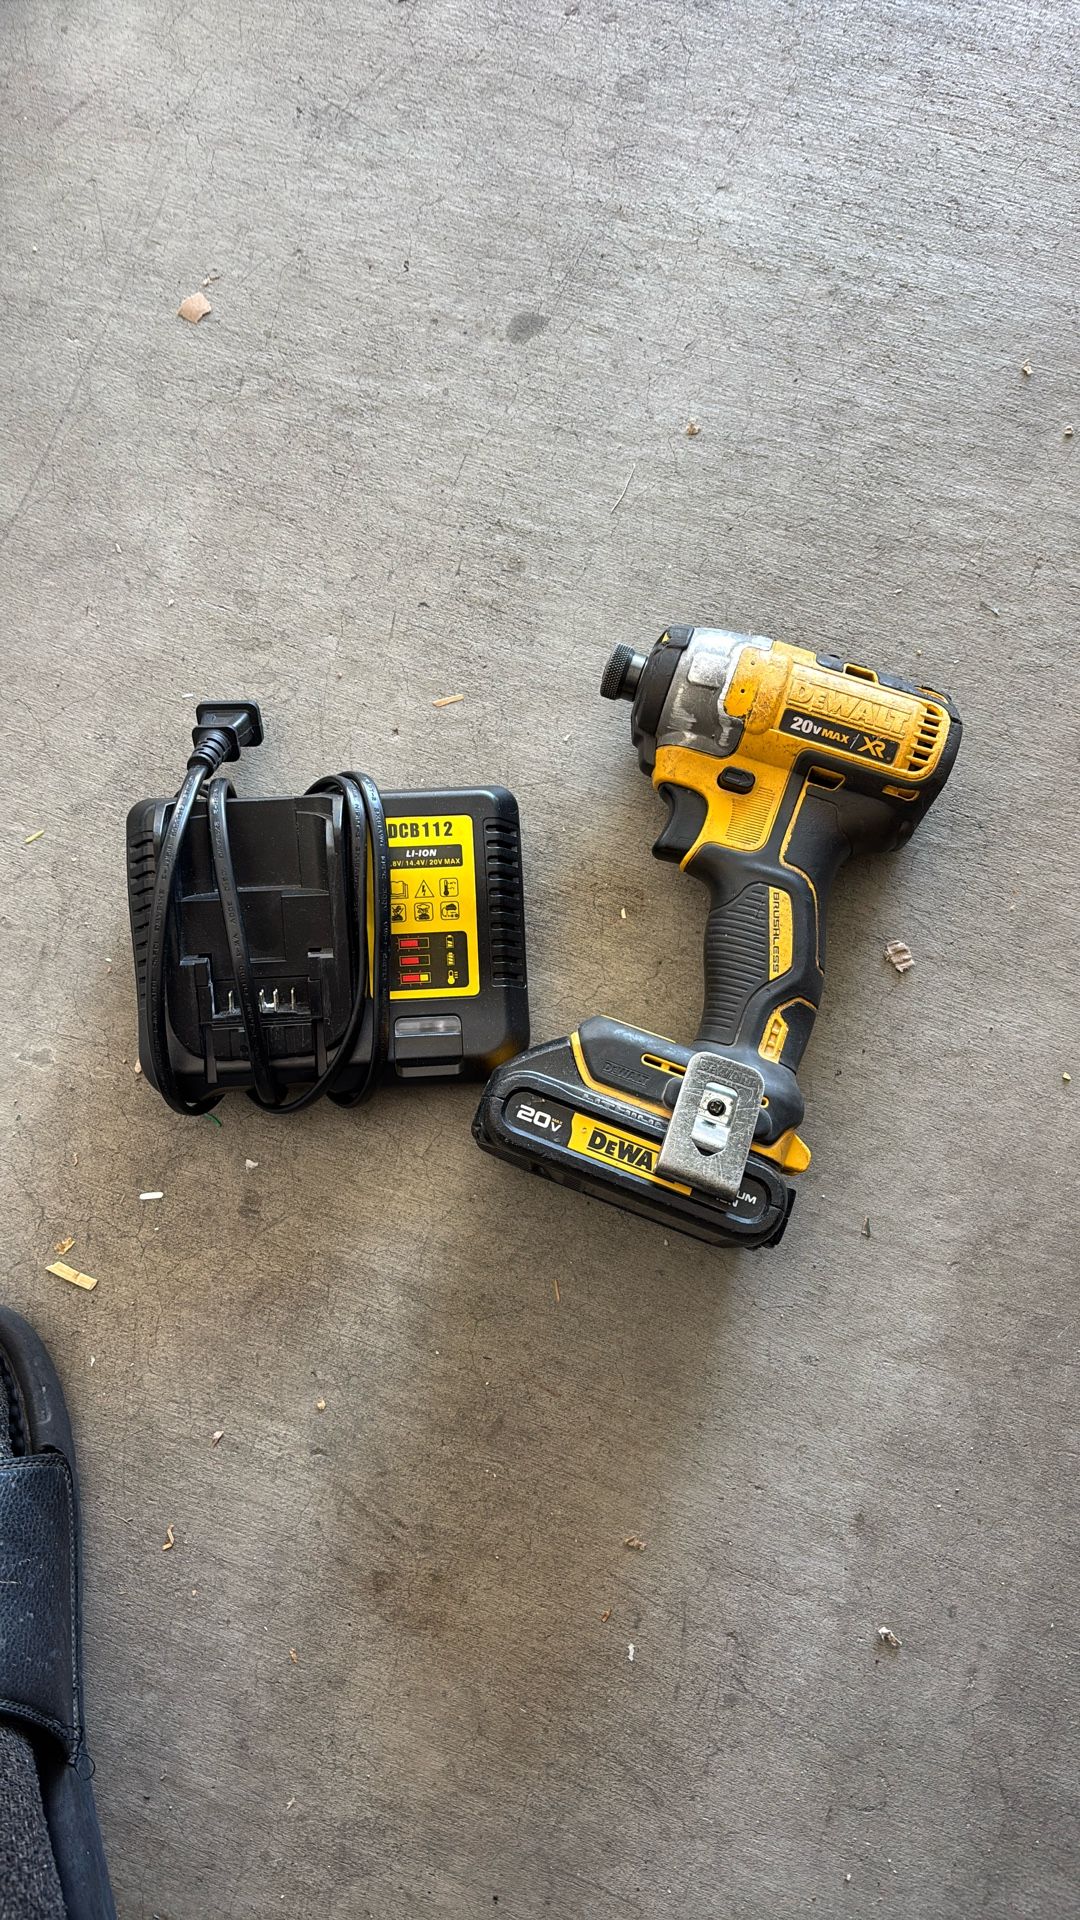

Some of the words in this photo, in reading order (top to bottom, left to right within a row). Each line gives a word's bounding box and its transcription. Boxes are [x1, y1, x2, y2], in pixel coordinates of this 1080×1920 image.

[788, 684, 911, 735] DEWALT
[821, 728, 850, 744] MAX
[857, 736, 886, 759] XR
[388, 821, 453, 839] DCB112
[405, 849, 437, 858] LI-ION
[772, 892, 780, 973] BRUSHLESS
[516, 1104, 562, 1132] 20V
[587, 1129, 653, 1171] DEWA
